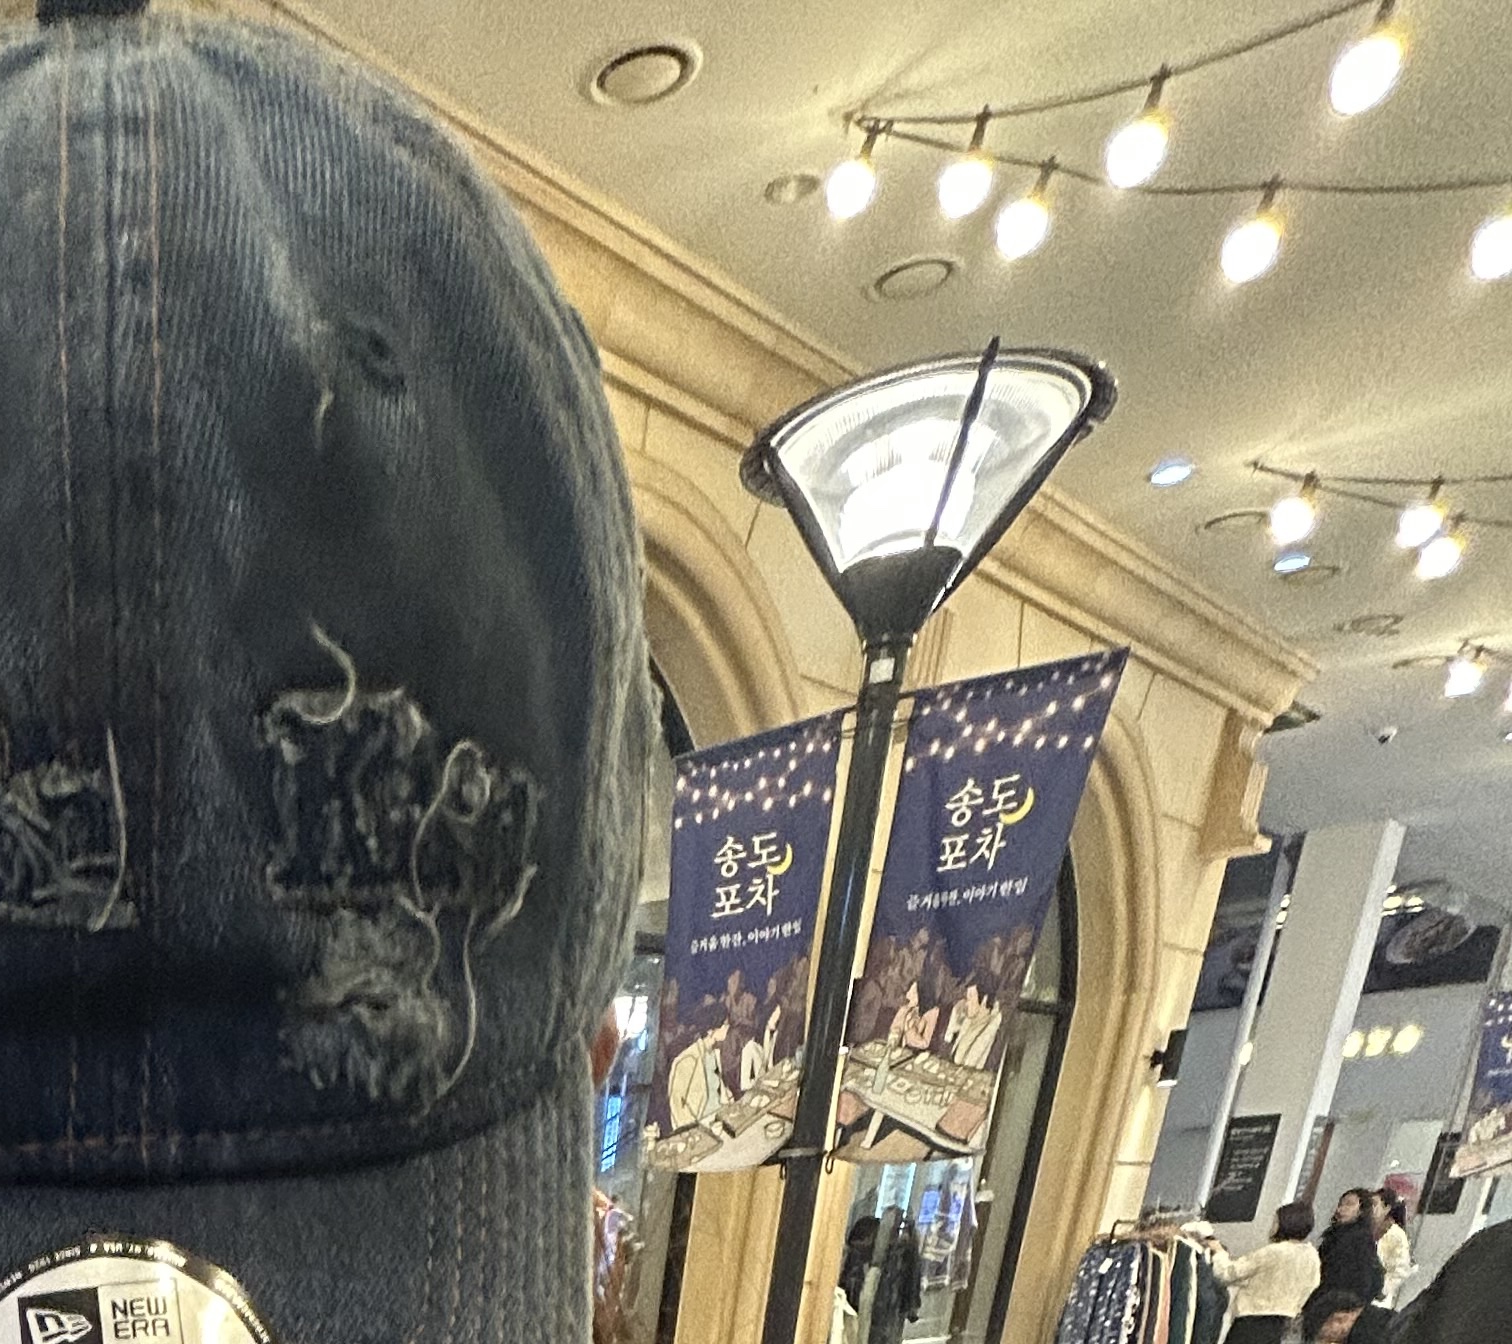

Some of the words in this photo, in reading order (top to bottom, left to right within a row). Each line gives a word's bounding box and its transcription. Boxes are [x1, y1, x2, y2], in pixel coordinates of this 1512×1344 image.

[945, 774, 1020, 827] 송도
[713, 832, 782, 878] 송도
[936, 822, 1006, 872] 포차
[710, 874, 780, 919] 포차
[110, 1296, 168, 1320] NEW
[113, 1317, 171, 1340] ERA
